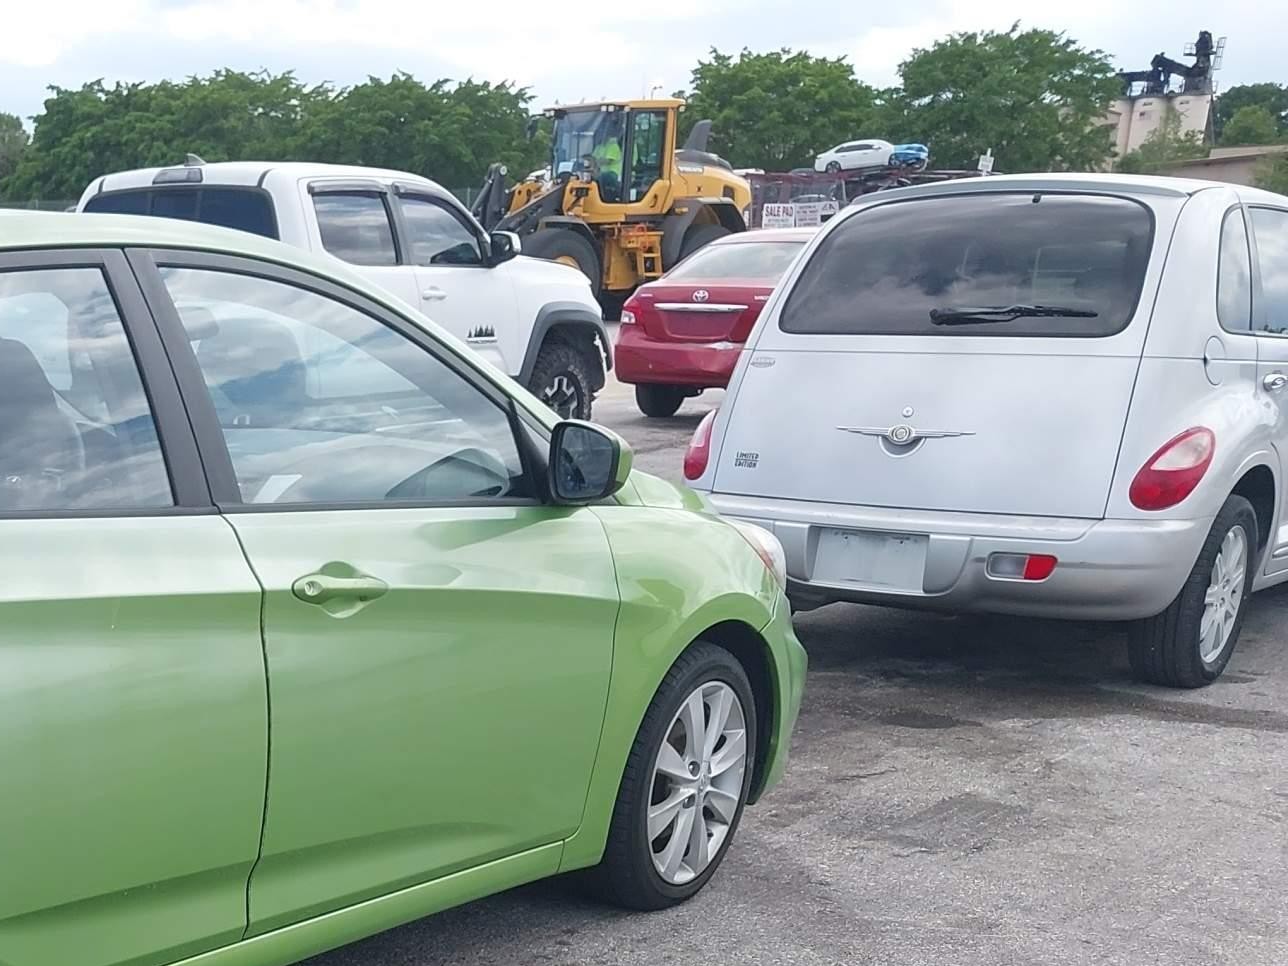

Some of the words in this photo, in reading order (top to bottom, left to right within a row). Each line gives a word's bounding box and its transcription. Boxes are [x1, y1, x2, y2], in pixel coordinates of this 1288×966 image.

[765, 205, 781, 217] SALE
[736, 451, 759, 459] LIMITED
[734, 460, 757, 468] EDITION
